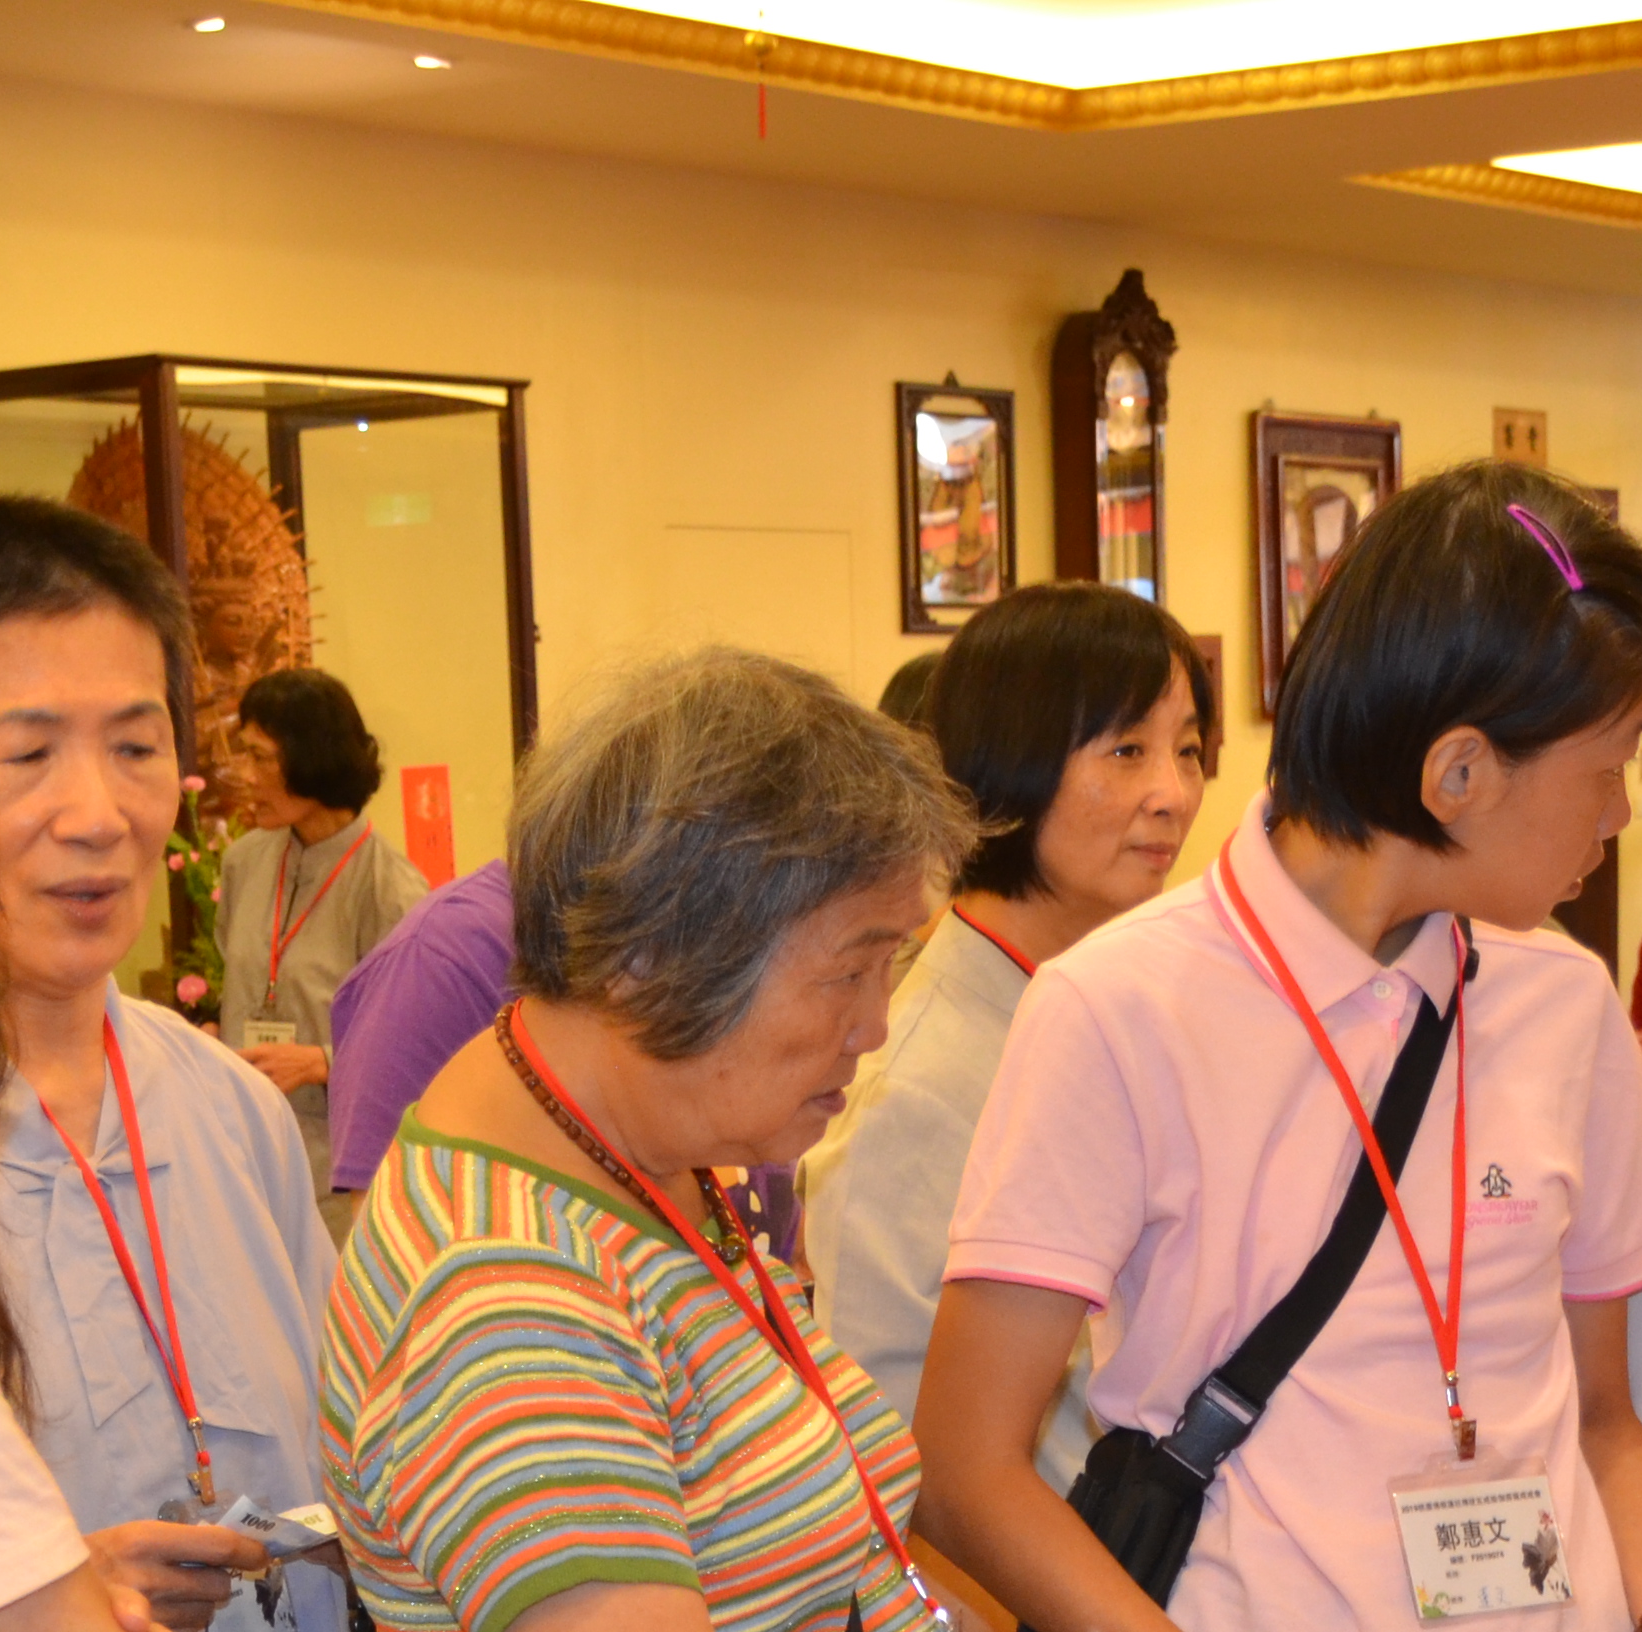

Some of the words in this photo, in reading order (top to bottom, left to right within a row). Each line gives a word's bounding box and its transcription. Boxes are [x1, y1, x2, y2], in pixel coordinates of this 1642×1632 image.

[239, 1511, 277, 1533] 1000
[1435, 1517, 1510, 1551] 鄭惠文
